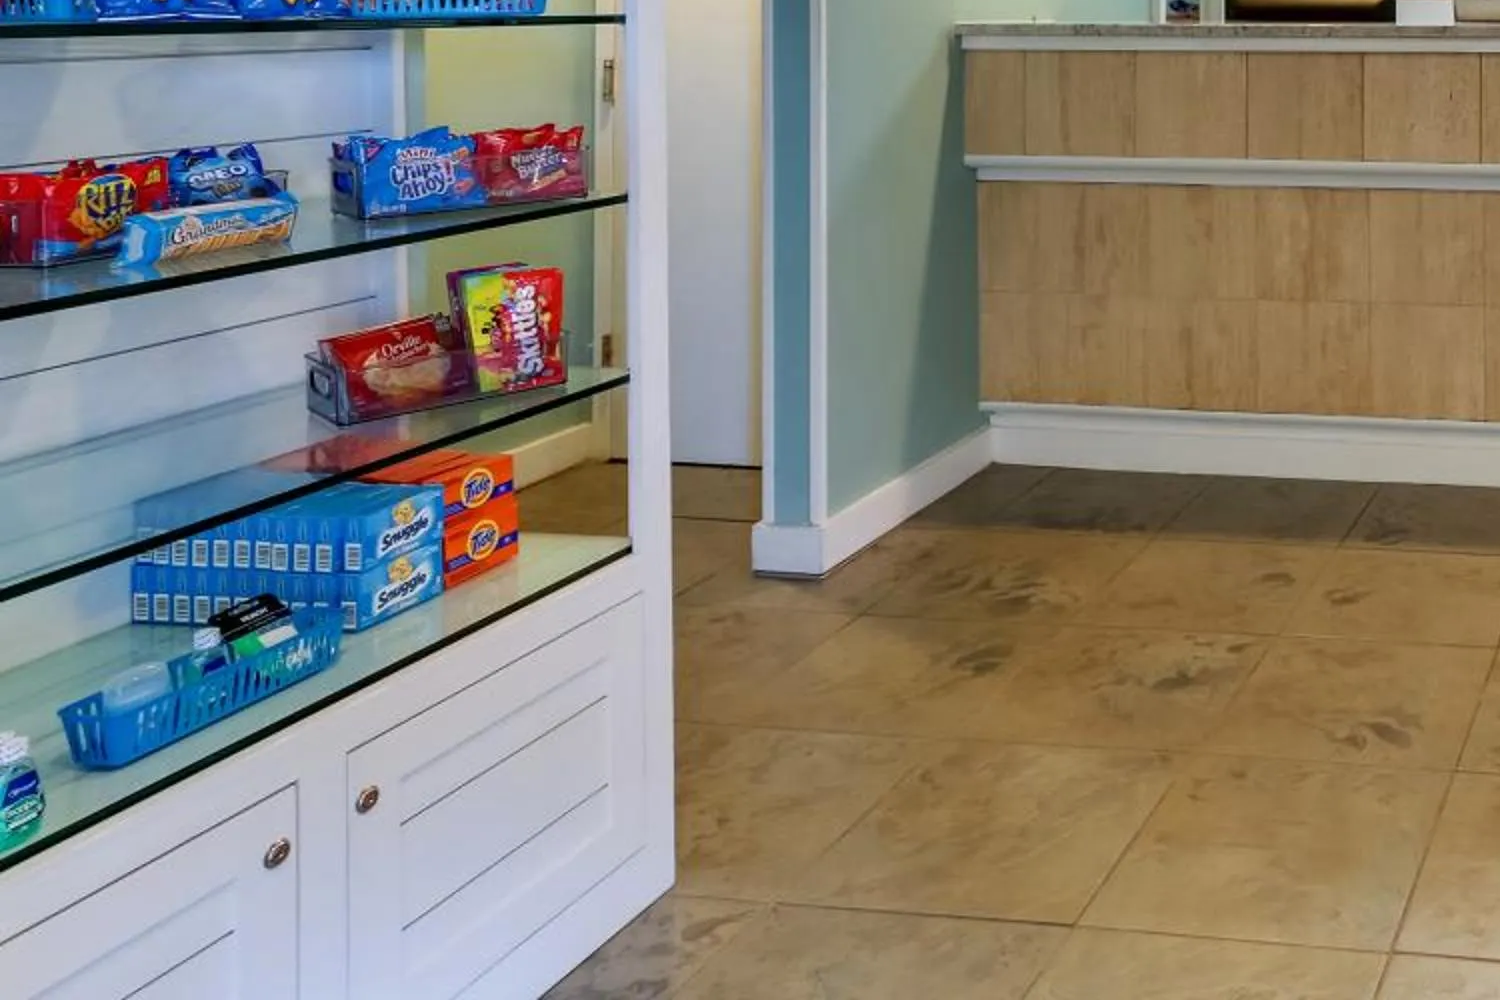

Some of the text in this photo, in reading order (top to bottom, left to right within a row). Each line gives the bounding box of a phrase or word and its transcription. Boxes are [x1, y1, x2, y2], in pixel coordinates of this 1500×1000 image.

[391, 162, 441, 185] Chips
[380, 515, 429, 552] Snuggle
[377, 571, 427, 610] Snuggle
